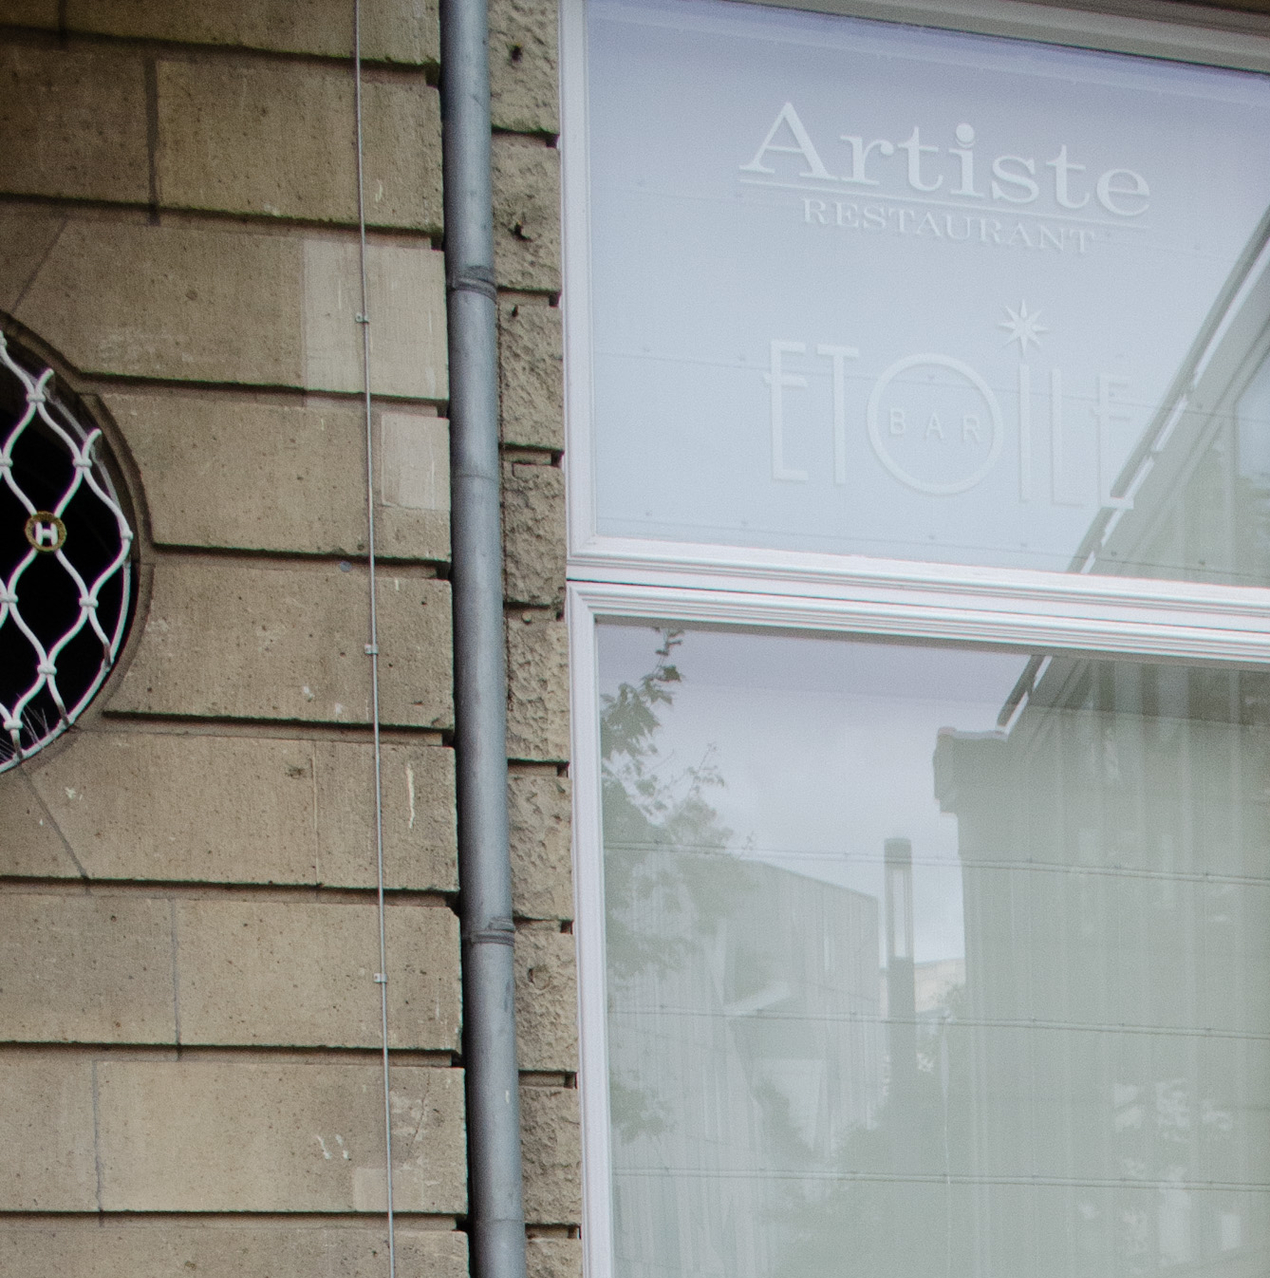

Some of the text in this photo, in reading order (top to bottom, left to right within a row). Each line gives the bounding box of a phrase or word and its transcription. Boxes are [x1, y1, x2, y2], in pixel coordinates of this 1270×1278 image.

[739, 101, 1151, 217] Artiste
[802, 198, 1098, 254] RESTAURANT
[762, 340, 1135, 510] ETOILE
[889, 406, 981, 443] BAR
